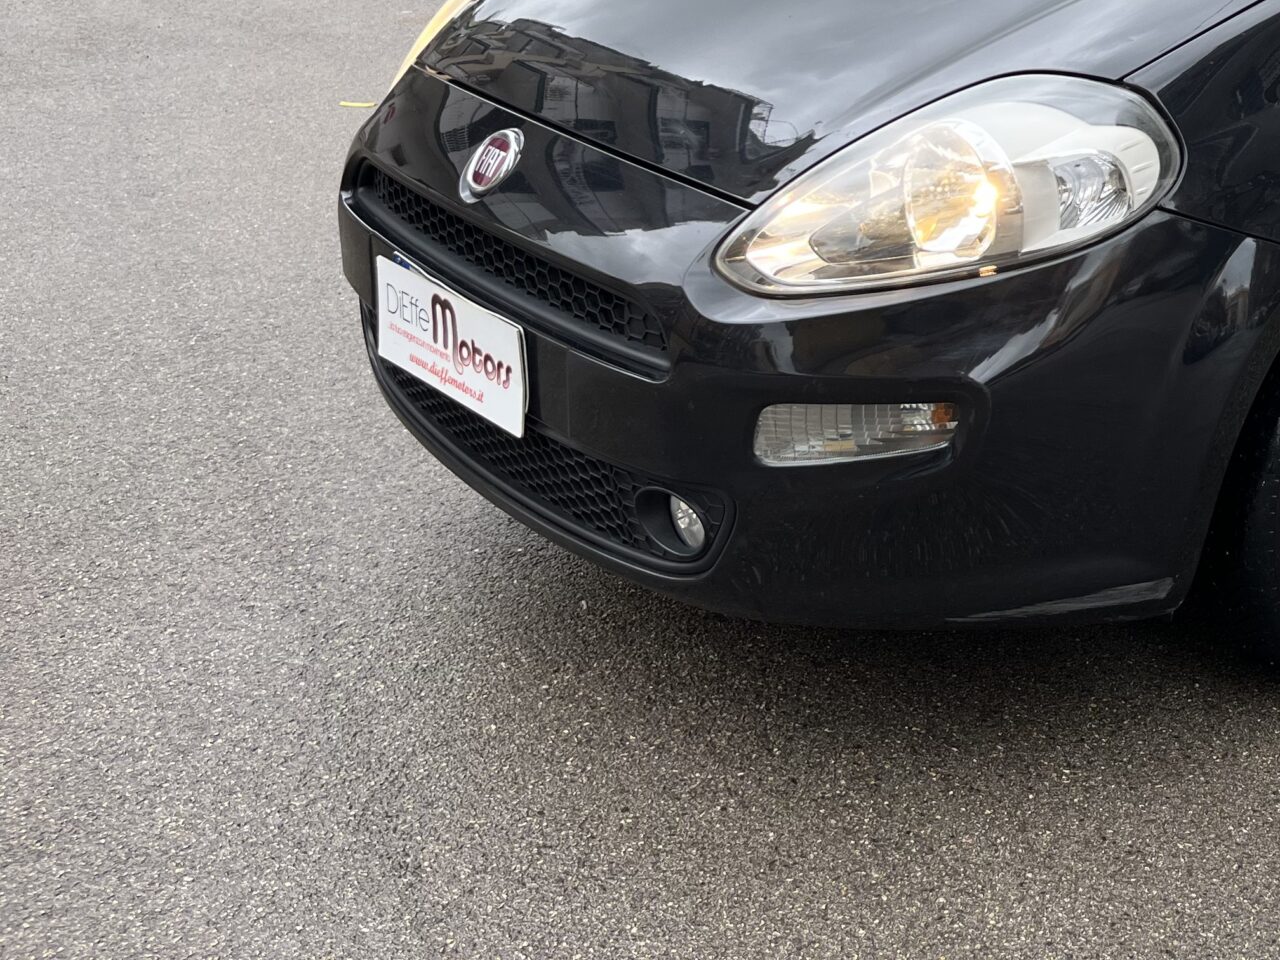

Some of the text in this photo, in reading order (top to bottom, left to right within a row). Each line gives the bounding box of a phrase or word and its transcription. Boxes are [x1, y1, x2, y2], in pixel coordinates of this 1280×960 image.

[475, 144, 507, 178] FIAT
[386, 283, 430, 332] DiEffe
[431, 293, 512, 389] Motors
